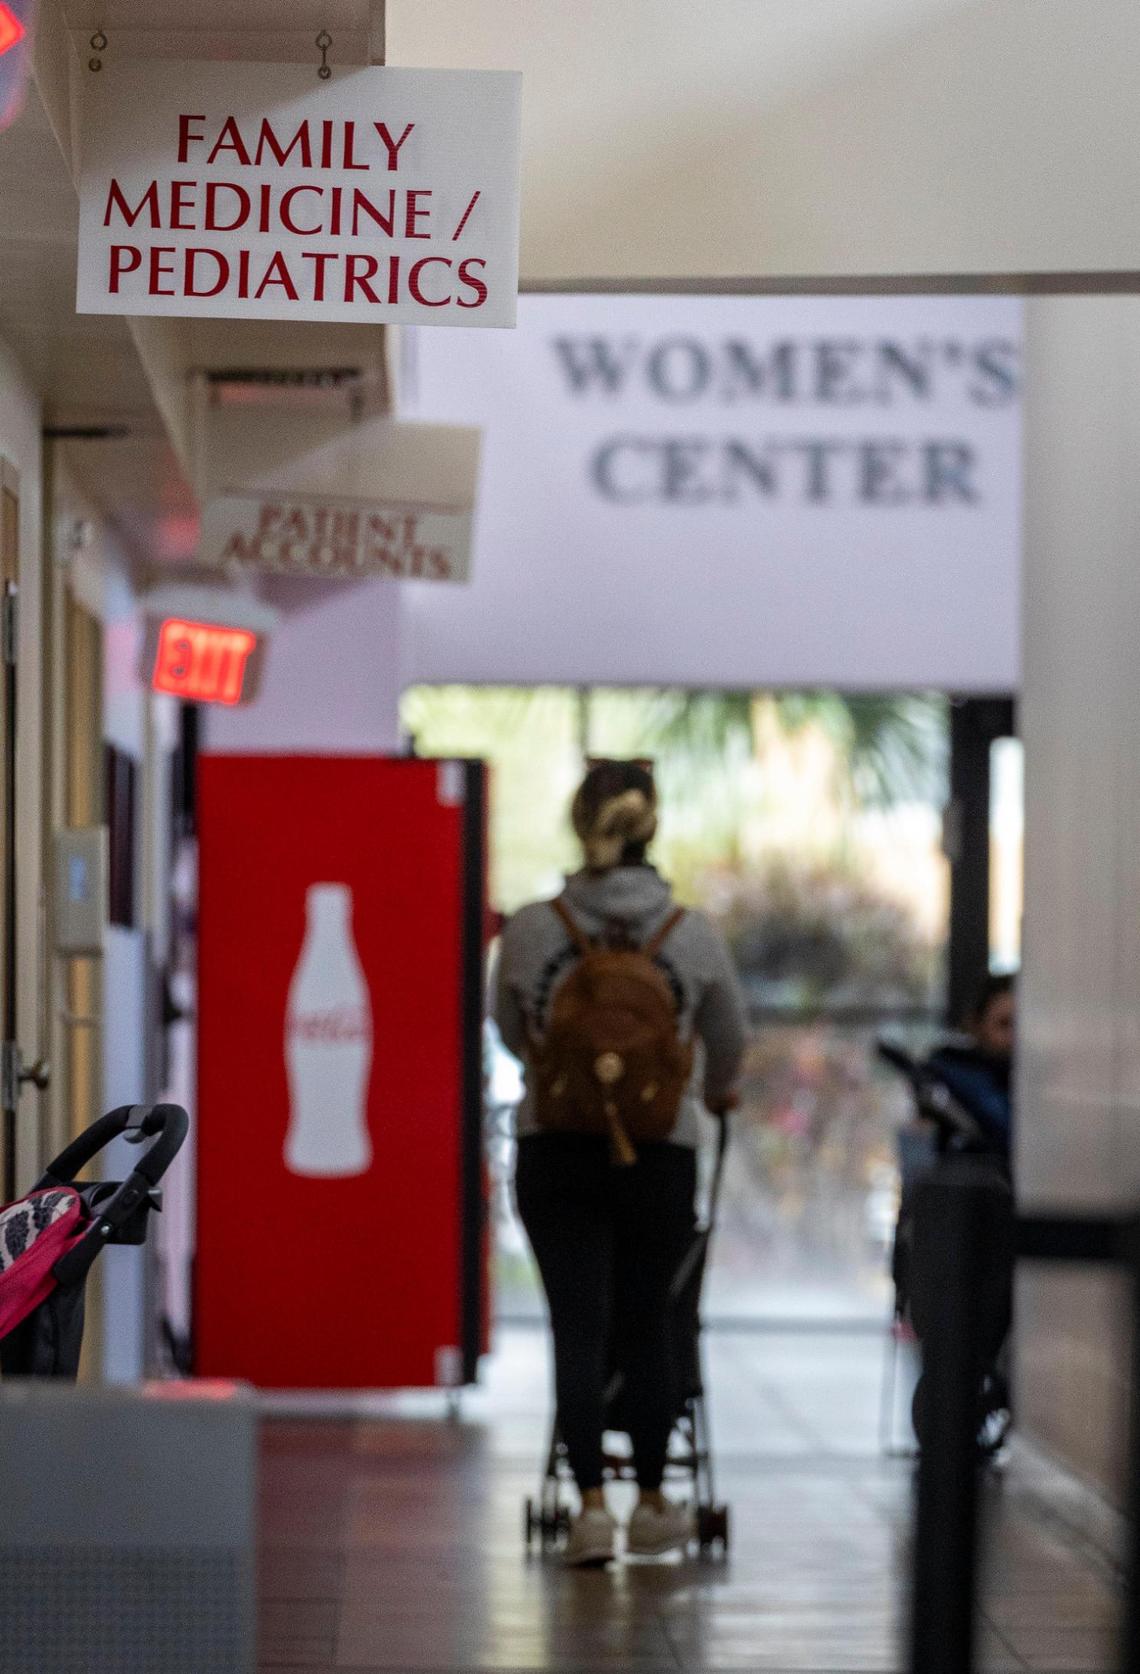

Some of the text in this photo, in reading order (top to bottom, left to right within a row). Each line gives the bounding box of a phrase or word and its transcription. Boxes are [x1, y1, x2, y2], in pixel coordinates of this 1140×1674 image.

[177, 114, 415, 171] FAMILY
[103, 178, 433, 240] MEDICINE
[108, 245, 488, 308] PEDIATRICS
[551, 335, 1019, 408] WOMEN'S
[590, 434, 982, 505] CENTER
[222, 532, 452, 581] ACCOUNTS
[258, 504, 420, 550] PATIENT
